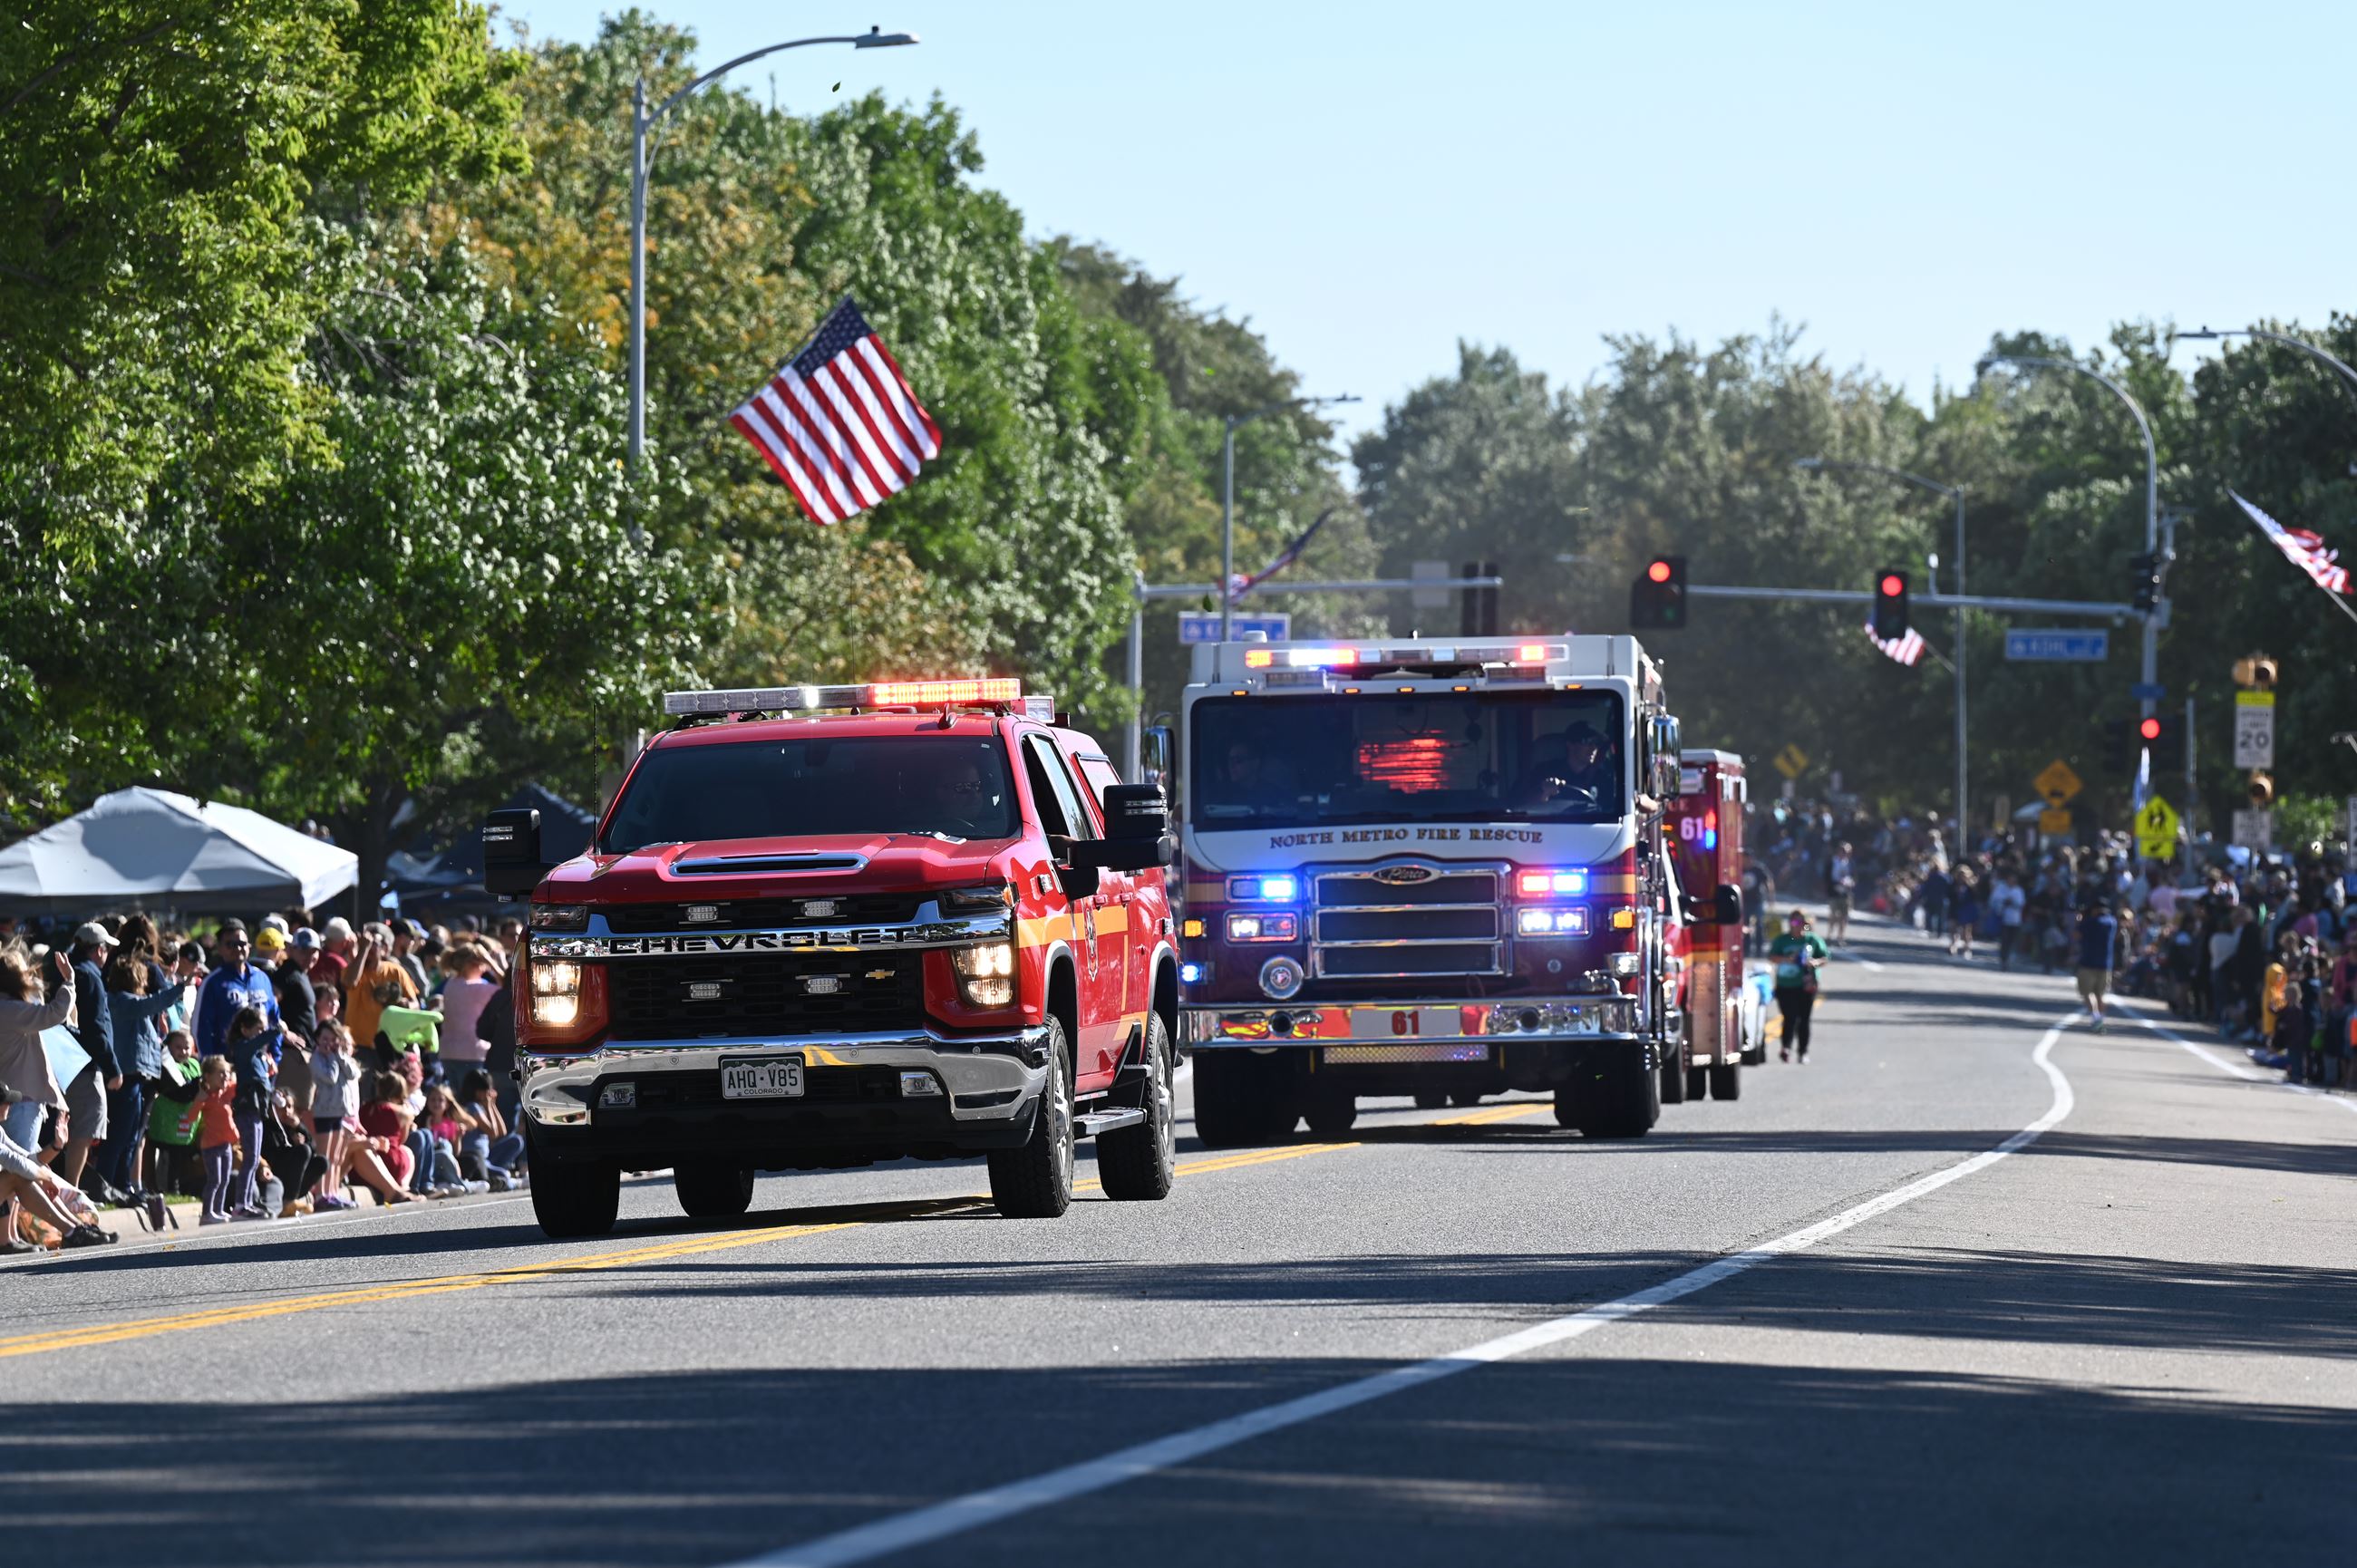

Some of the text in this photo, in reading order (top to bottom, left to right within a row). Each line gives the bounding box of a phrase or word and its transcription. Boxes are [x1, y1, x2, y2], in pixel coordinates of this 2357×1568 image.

[2240, 730, 2269, 750] 20
[1270, 828, 1543, 849] NORTH METRO FIRE RESCUE
[1680, 817, 1704, 841] 61
[608, 927, 916, 954] CHEVROLET
[1392, 1010, 1420, 1036] 61
[743, 1088, 783, 1096] COLORADO
